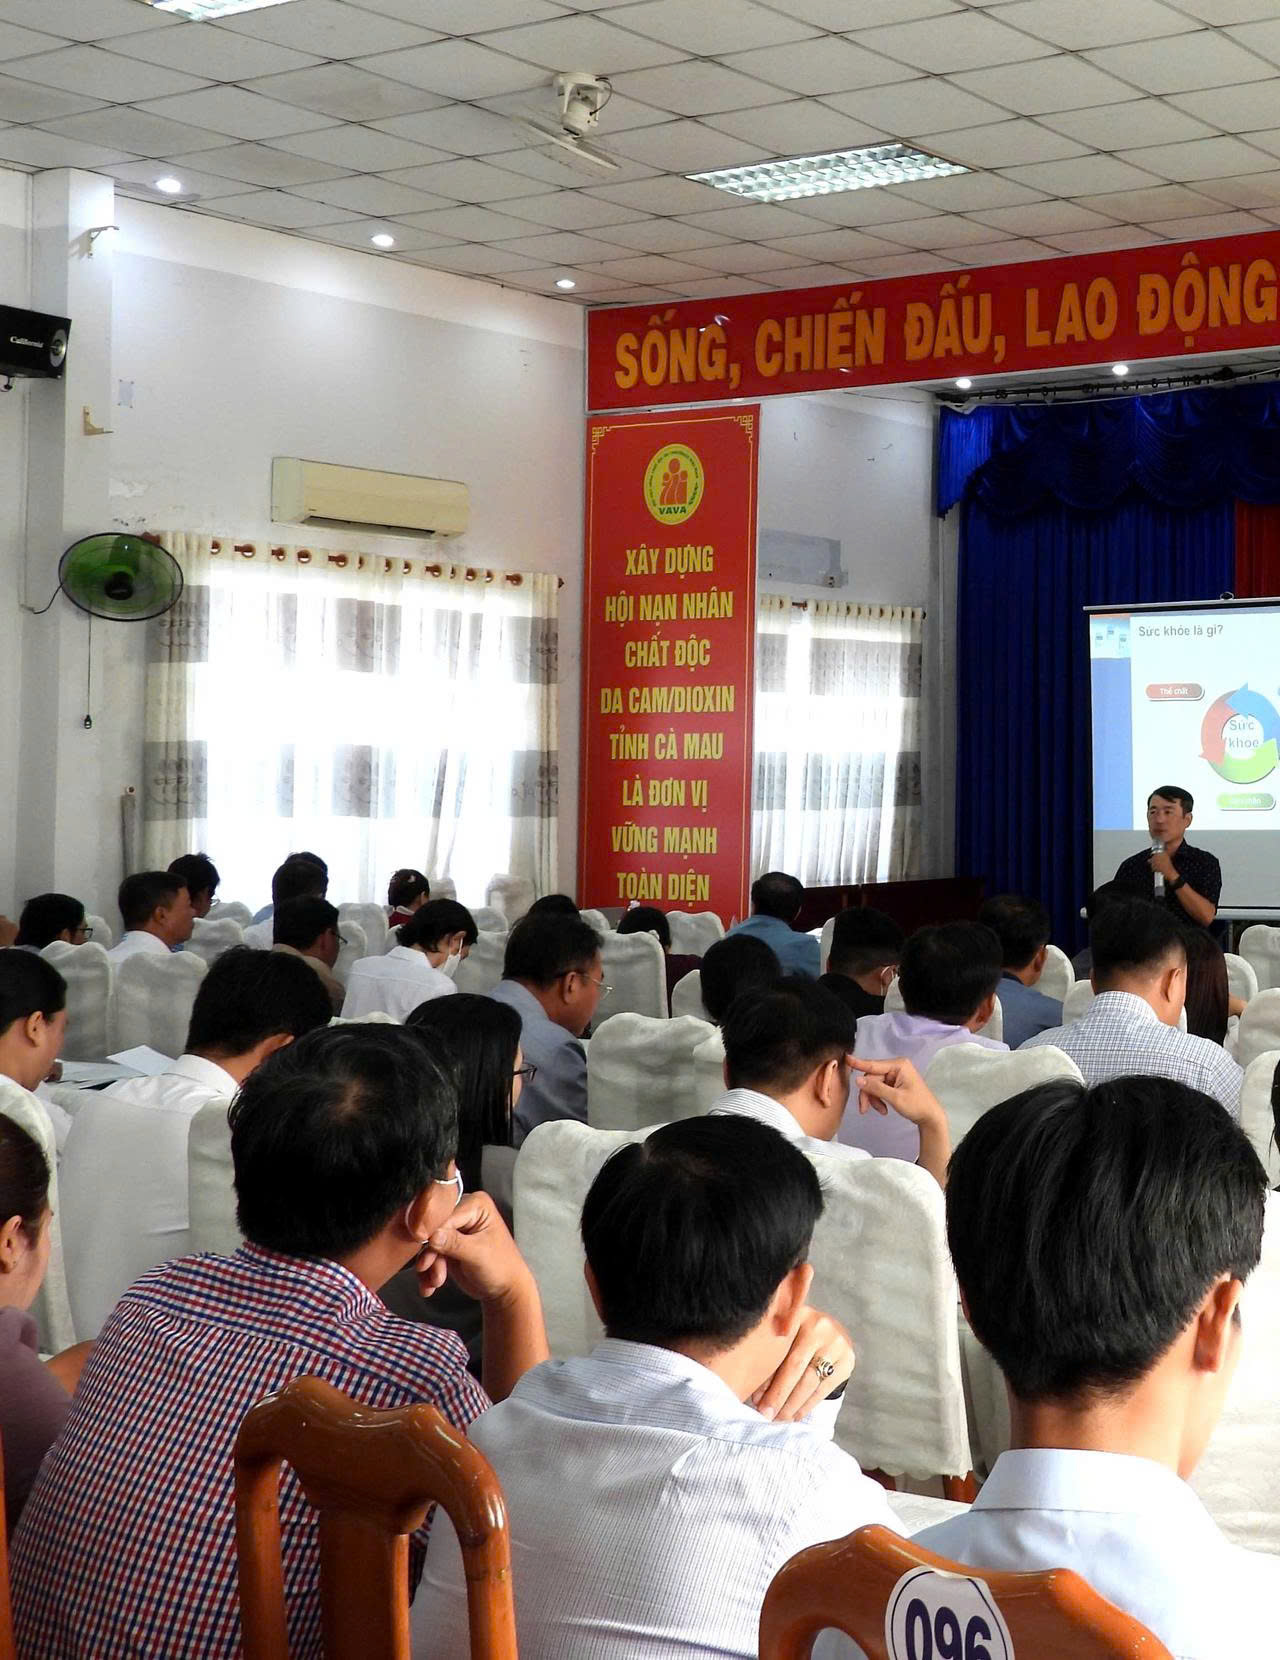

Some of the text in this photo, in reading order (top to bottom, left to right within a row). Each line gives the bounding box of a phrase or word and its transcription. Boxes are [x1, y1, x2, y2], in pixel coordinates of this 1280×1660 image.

[614, 309, 741, 389] SỐNG,
[754, 291, 886, 379] CHIẾN
[904, 275, 1005, 364] ĐẤU,
[1025, 277, 1118, 348] LAO
[1136, 251, 1279, 347] ĐỘNG
[659, 506, 687, 515] VAVA
[625, 543, 714, 579] XÂY DỰNG
[605, 586, 734, 627] HỘI NẠN NHÂN
[624, 631, 711, 672] CHẤT ĐỘC
[600, 685, 735, 714] DA CAM/DIOXIN
[609, 724, 724, 760] TỈNH CÀ MAU
[622, 774, 708, 813] LÀ ĐƠN VỊ
[611, 821, 718, 860] VỮNG MẠNH
[616, 867, 710, 907] TOÀN DIỆN
[905, 1597, 993, 1660] 096
